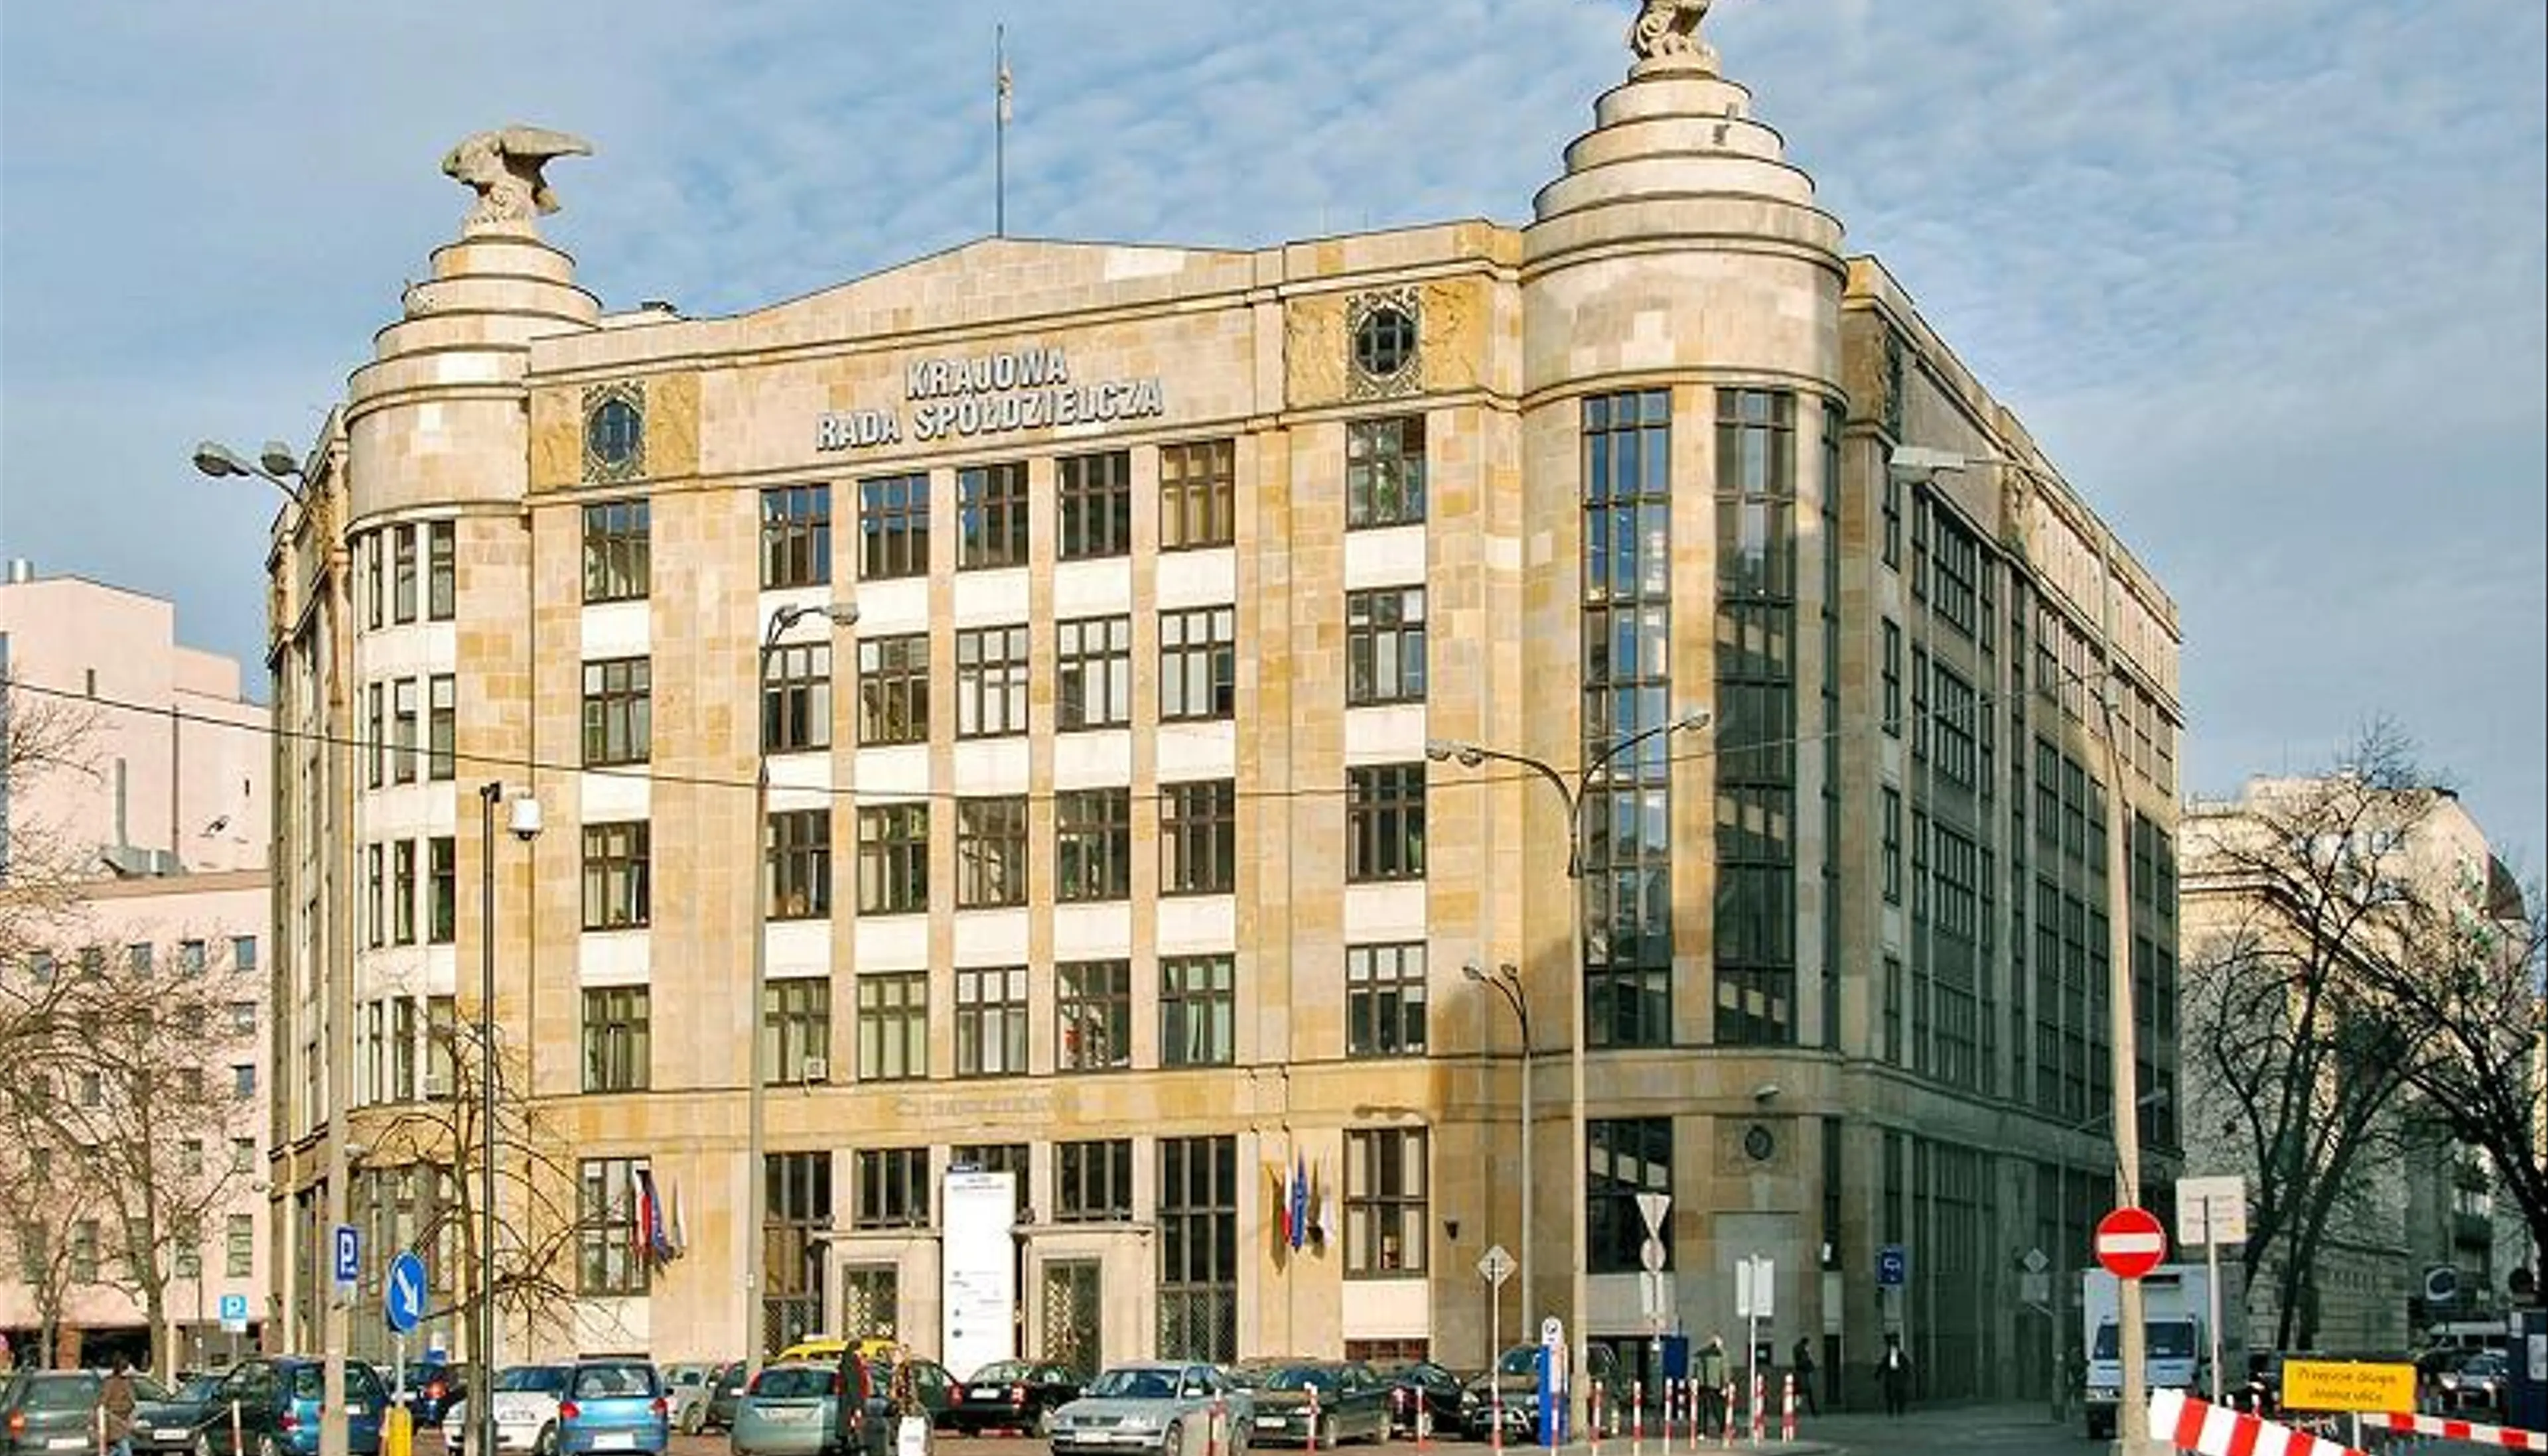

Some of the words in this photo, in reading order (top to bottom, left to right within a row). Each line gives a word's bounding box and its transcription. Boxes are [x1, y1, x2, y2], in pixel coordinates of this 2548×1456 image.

[906, 349, 1068, 399] KRAJOWA
[816, 410, 902, 452] RADA
[340, 1232, 355, 1274] P
[226, 1297, 242, 1316] P
